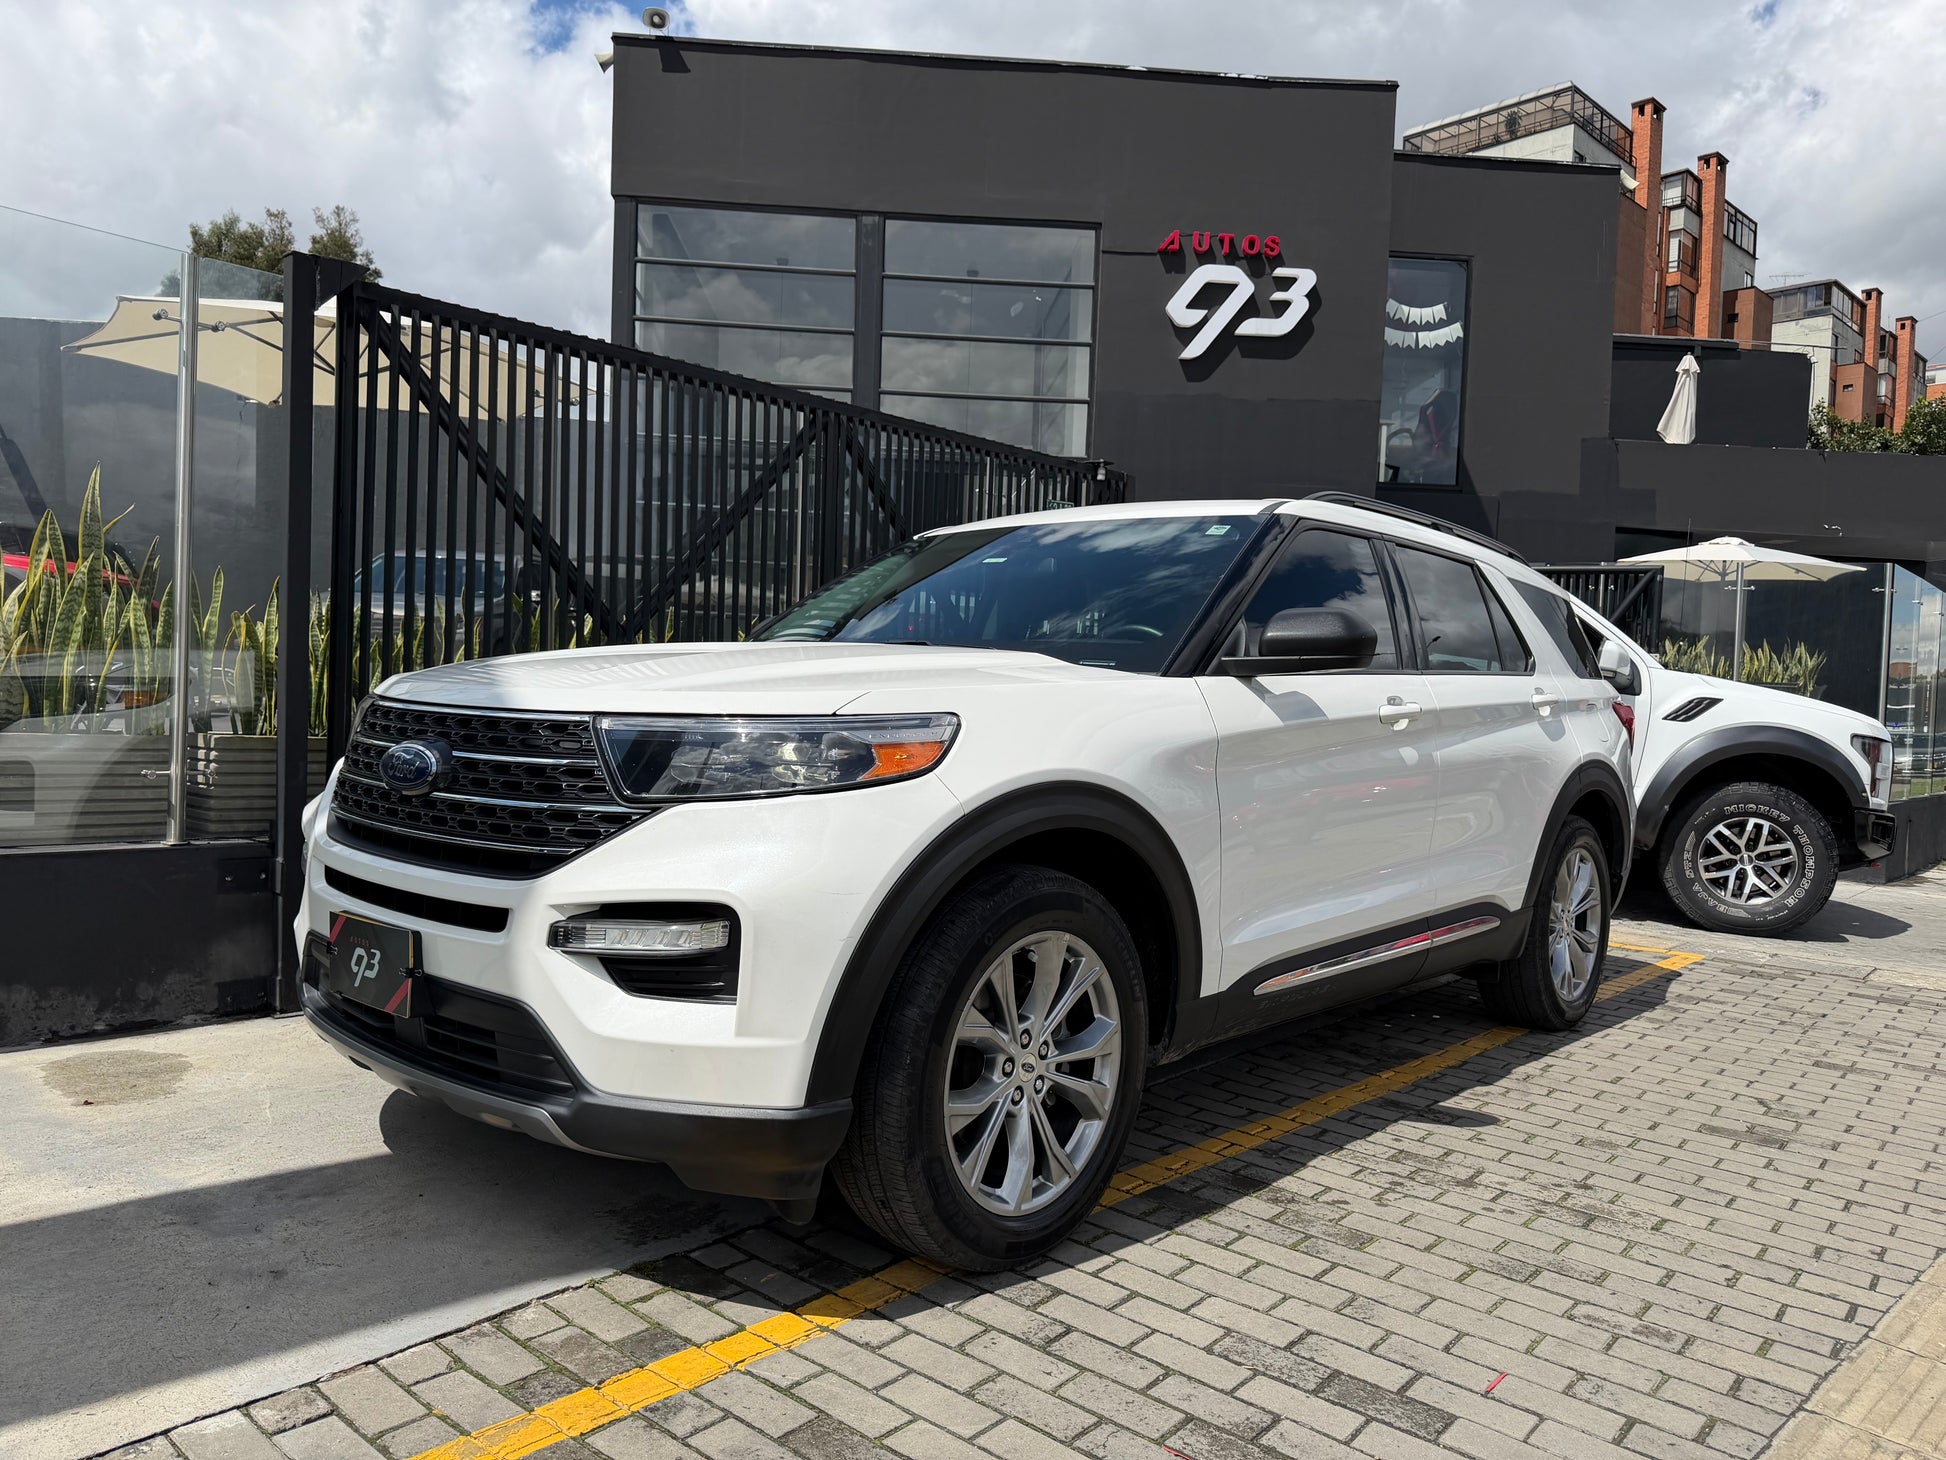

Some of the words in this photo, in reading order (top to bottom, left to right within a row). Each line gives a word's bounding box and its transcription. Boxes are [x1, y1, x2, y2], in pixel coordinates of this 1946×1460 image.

[1158, 230, 1281, 257] AUTOS
[1165, 264, 1317, 360] 93
[388, 751, 420, 779] Ford
[1723, 804, 1791, 823] MICKEY
[1784, 824, 1815, 908] THOMPSON
[350, 946, 381, 988] 93
